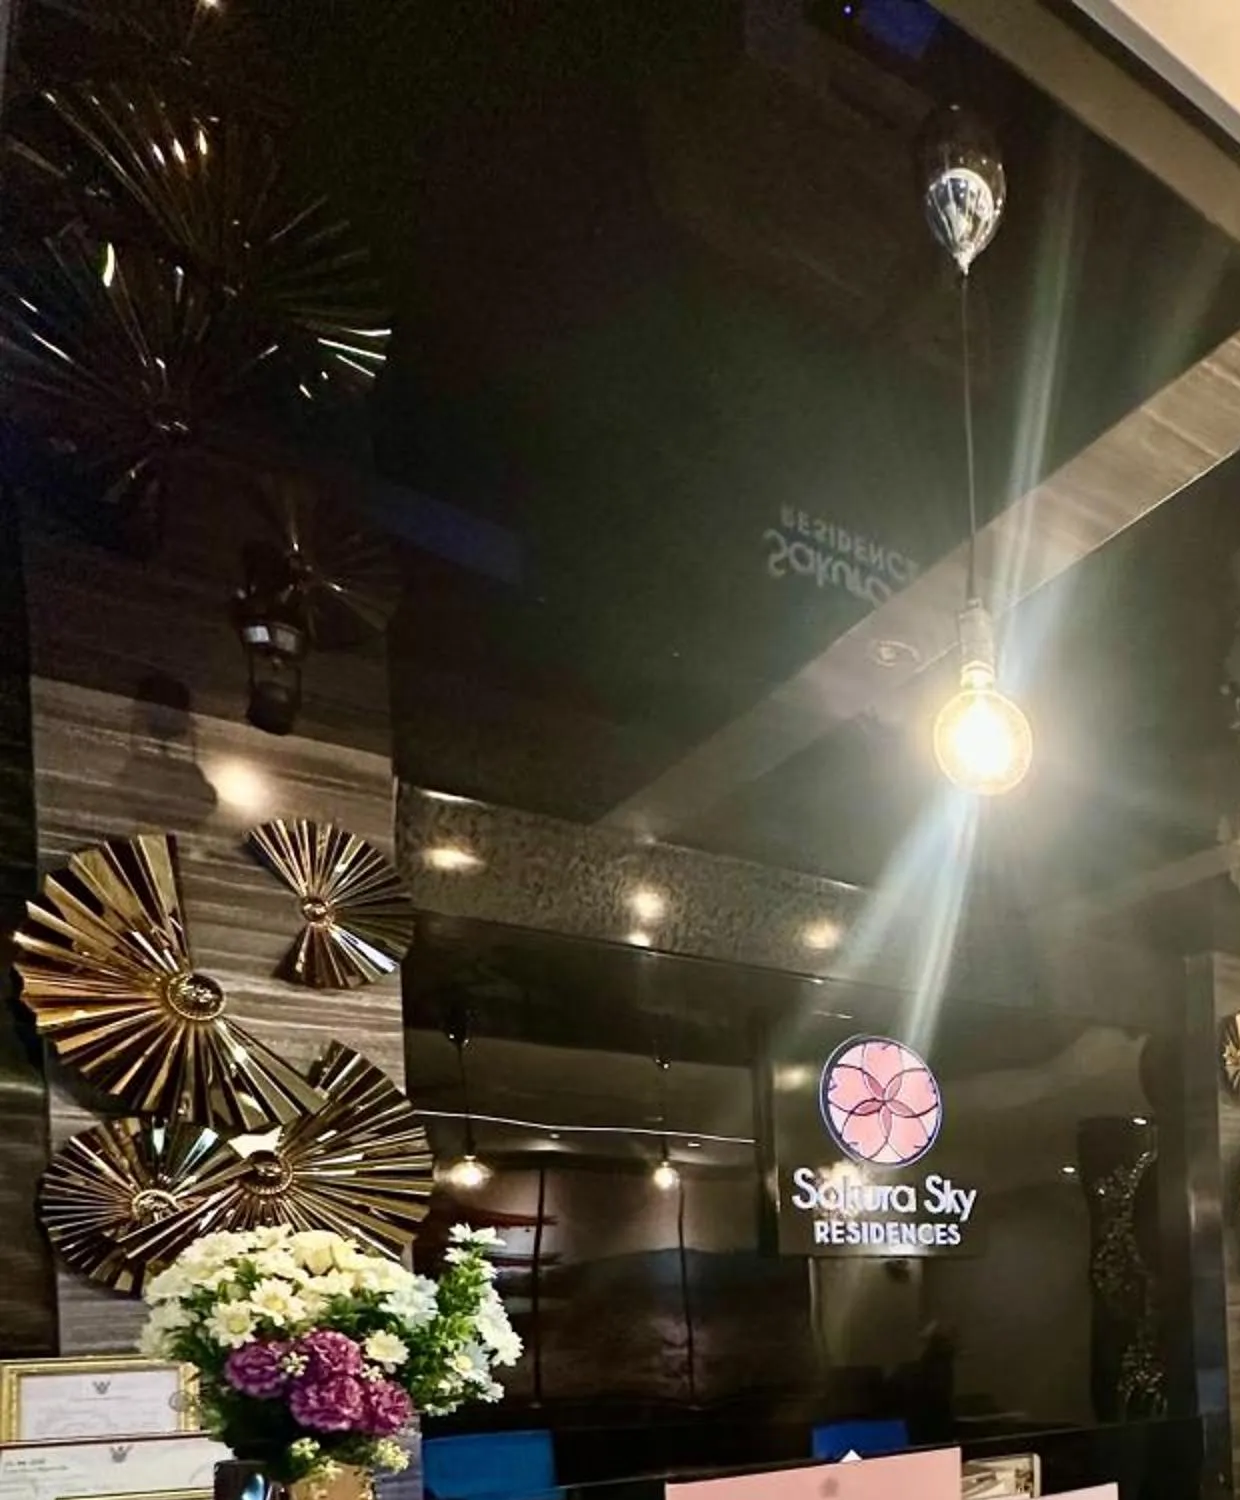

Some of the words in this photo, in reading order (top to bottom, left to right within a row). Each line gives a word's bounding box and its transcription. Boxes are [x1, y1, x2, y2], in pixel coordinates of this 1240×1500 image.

[792, 1167, 917, 1213] Sakura
[923, 1174, 977, 1222] Sky
[813, 1219, 961, 1245] RESIDENCES
